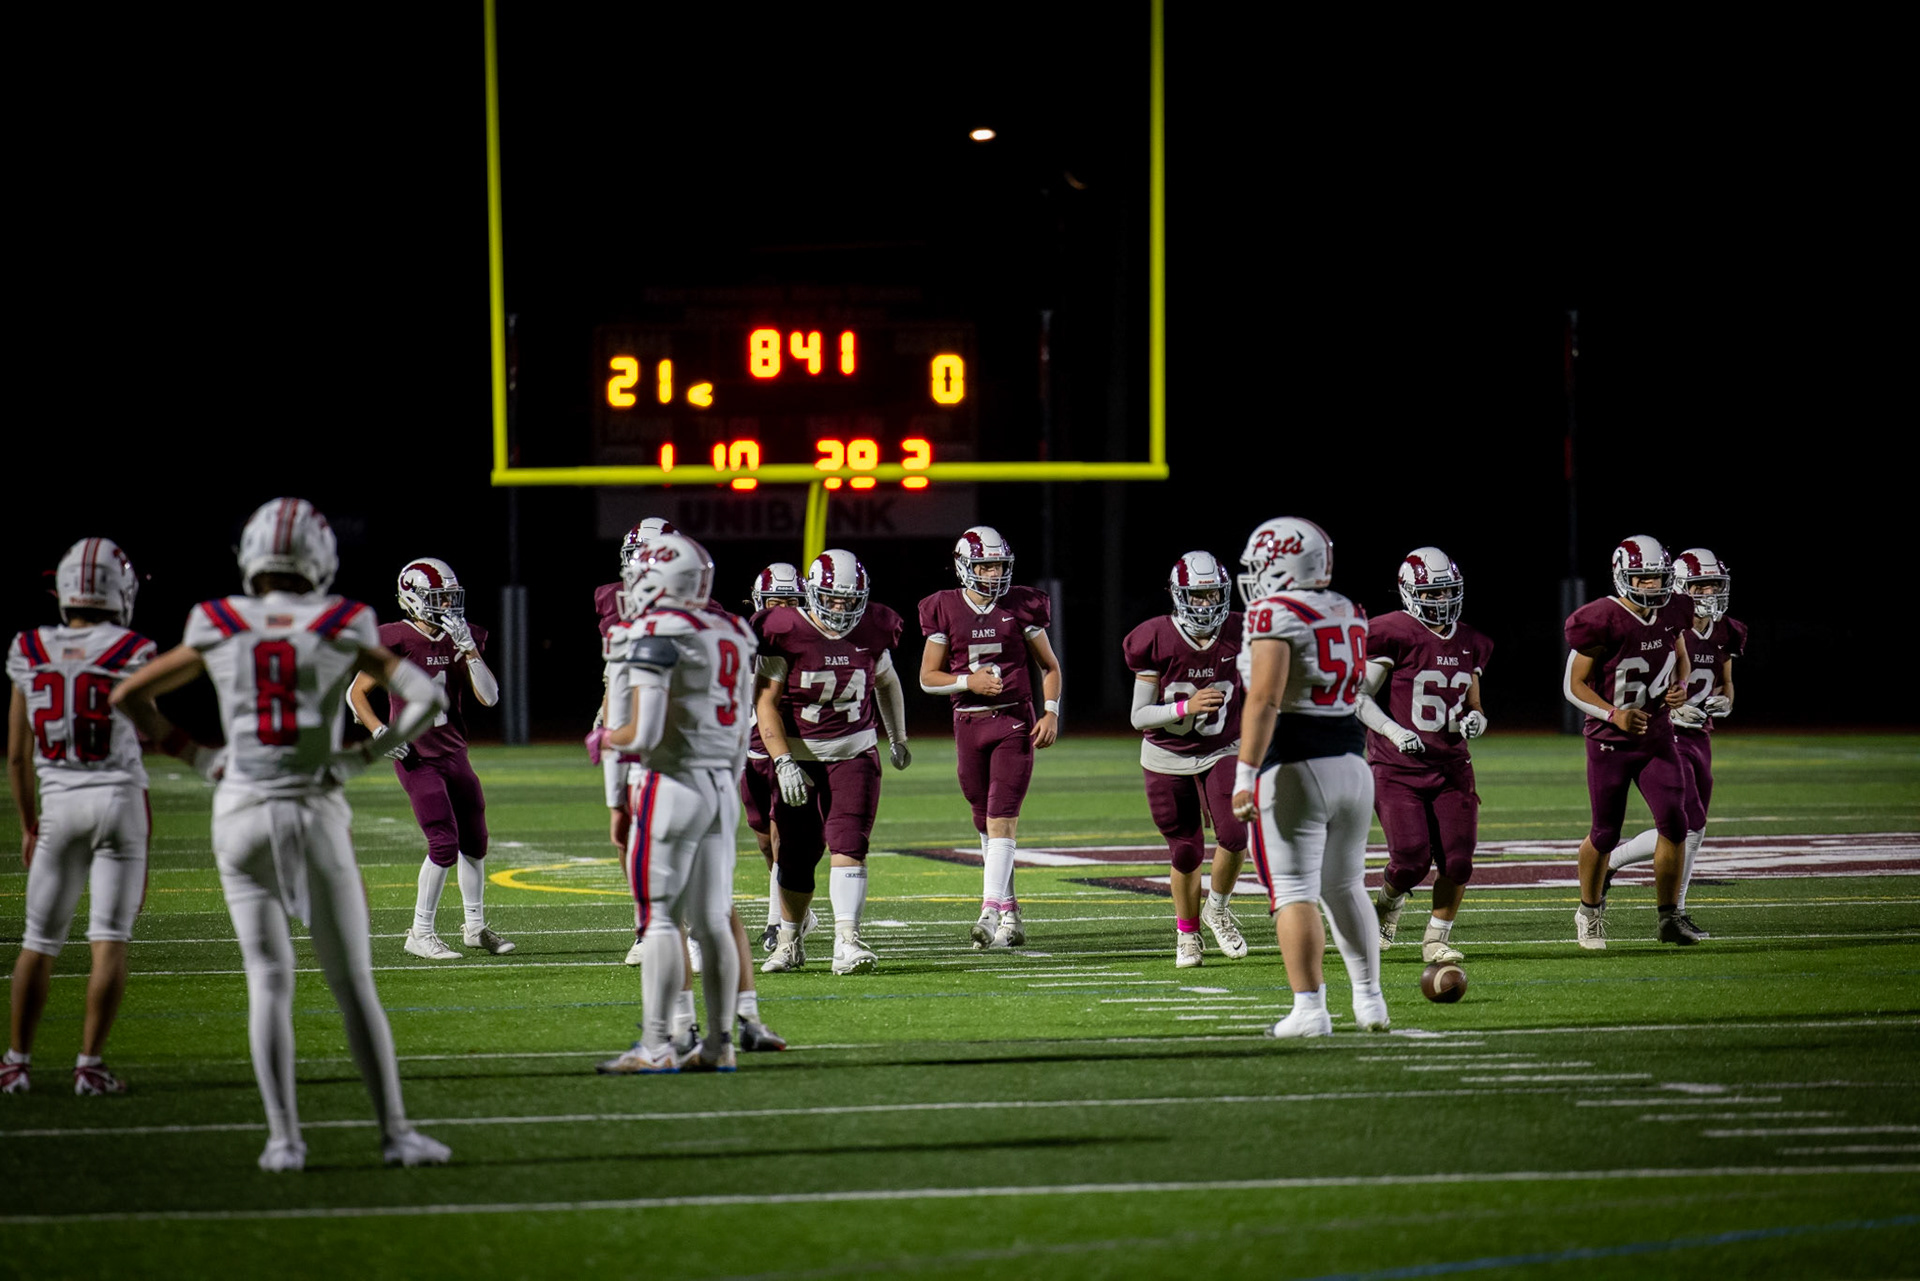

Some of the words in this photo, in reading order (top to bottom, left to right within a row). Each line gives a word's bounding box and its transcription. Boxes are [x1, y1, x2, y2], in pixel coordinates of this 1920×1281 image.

[931, 354, 965, 404] 0
[712, 439, 760, 490] 10
[676, 498, 898, 534] UNIBNK
[971, 628, 996, 639] RAMS
[1248, 608, 1273, 633] 58
[426, 655, 450, 666] RAMS
[824, 655, 850, 666] RAMS
[1310, 624, 1368, 706] 58
[1436, 655, 1459, 666] RAMS
[1640, 638, 1663, 651] RAMS
[1693, 653, 1715, 664] RAMS
[252, 639, 298, 747] 8
[716, 638, 740, 727] 9
[1187, 667, 1215, 678] RAMS
[1612, 650, 1677, 711] 64
[32, 671, 113, 763] 28
[800, 668, 867, 724] 74
[1411, 669, 1473, 733] 62
